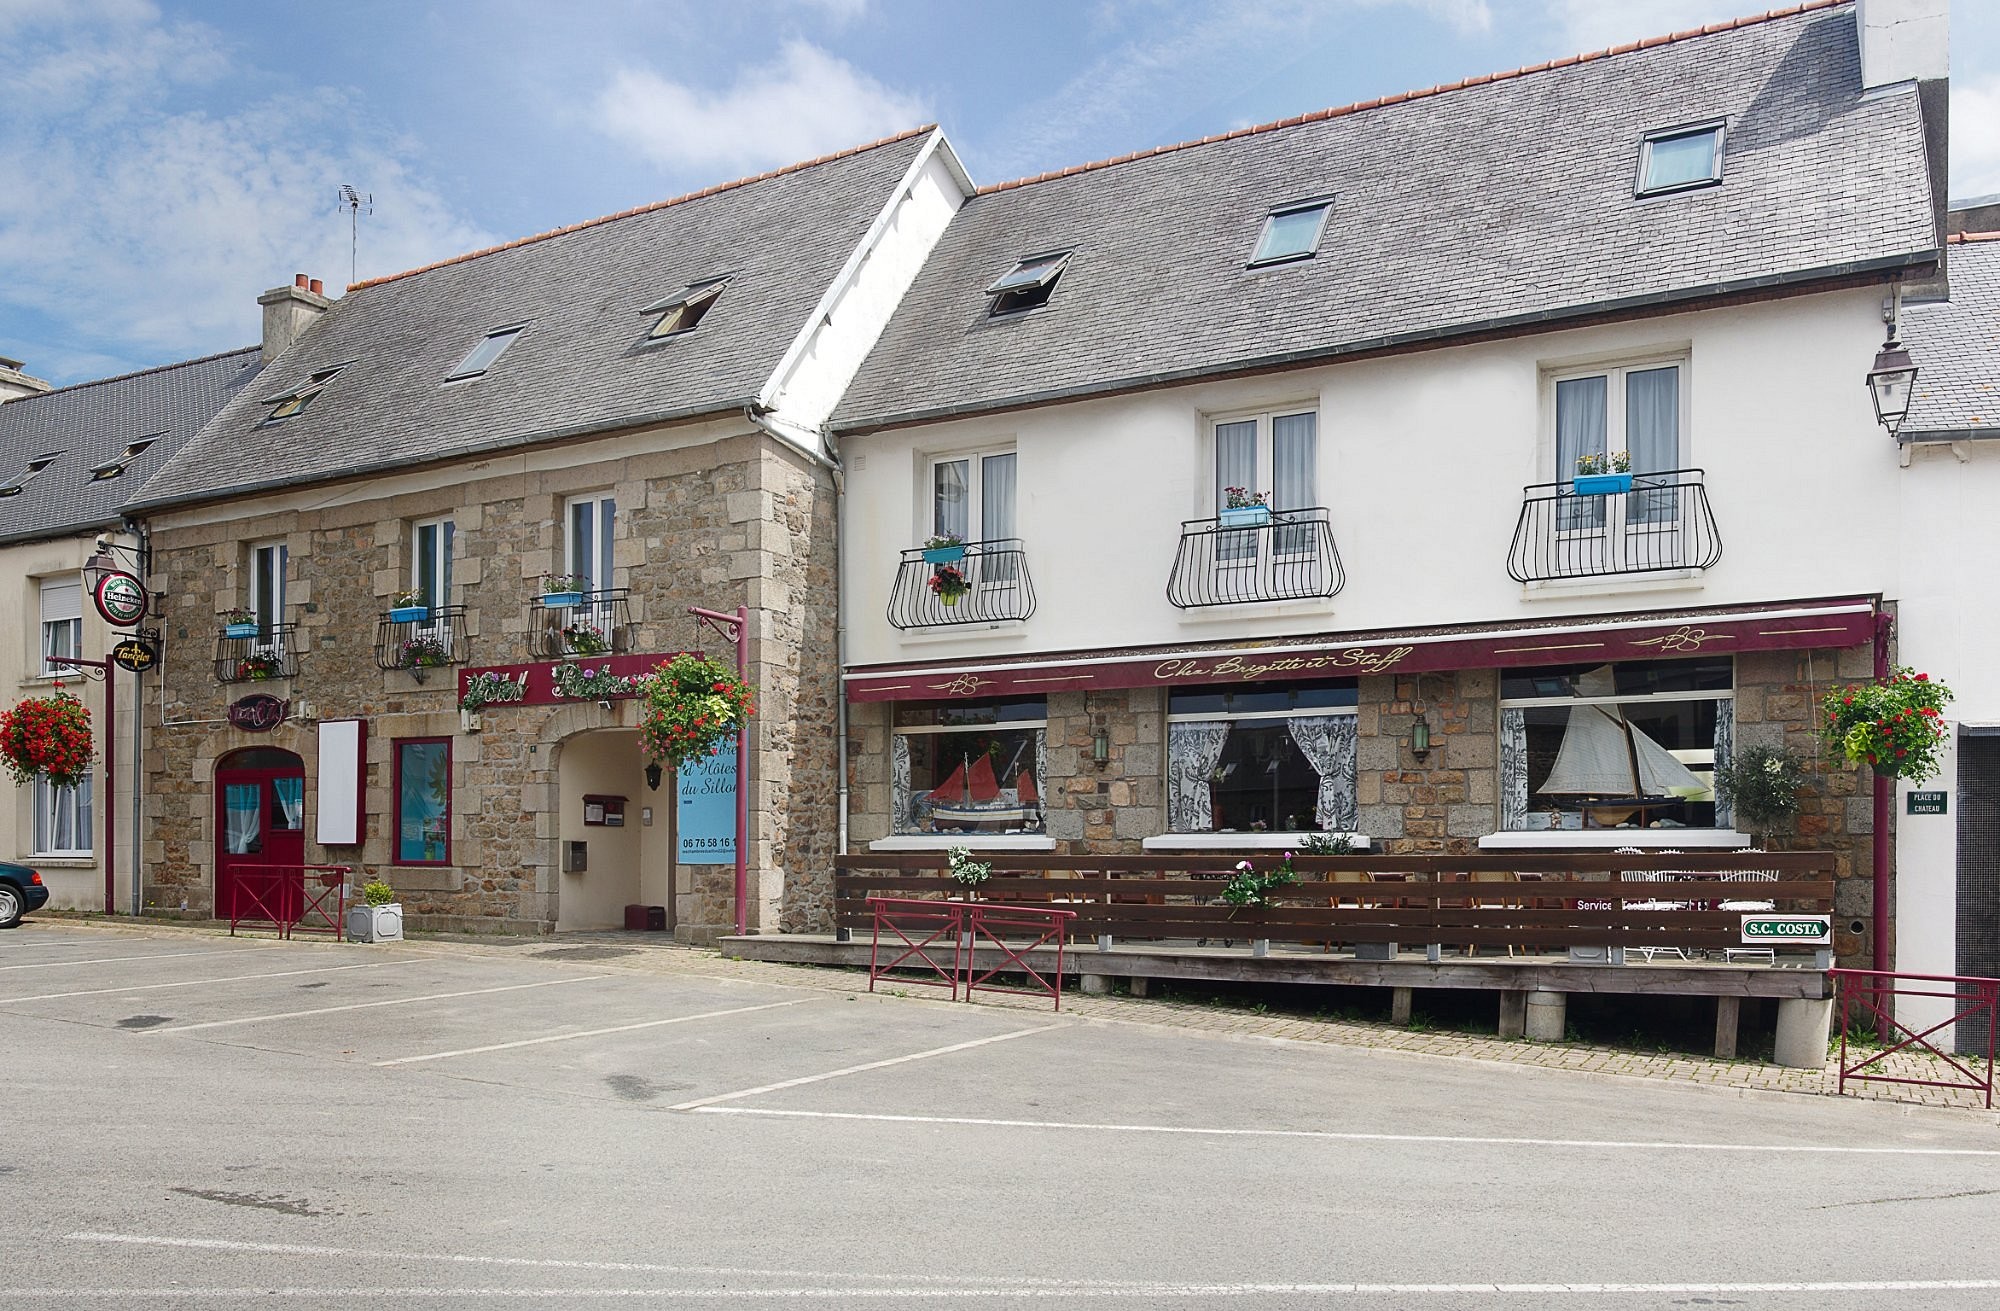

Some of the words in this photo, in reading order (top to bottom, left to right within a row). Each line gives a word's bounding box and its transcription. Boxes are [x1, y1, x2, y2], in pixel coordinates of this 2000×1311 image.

[106, 592, 142, 605] Heineken
[1211, 656, 1305, 682] Brigitte
[1304, 655, 1334, 669] et
[1331, 646, 1414, 673] Staff
[682, 780, 698, 796] du
[1913, 793, 1932, 801] PLACE
[1932, 793, 1941, 801] DU
[683, 838, 693, 848] 06
[695, 838, 705, 848] 76
[707, 838, 718, 848] 58
[720, 837, 730, 847] 16
[1577, 900, 1612, 910] Service
[1749, 923, 1774, 934] S.C.
[1776, 923, 1820, 935] COSTA
